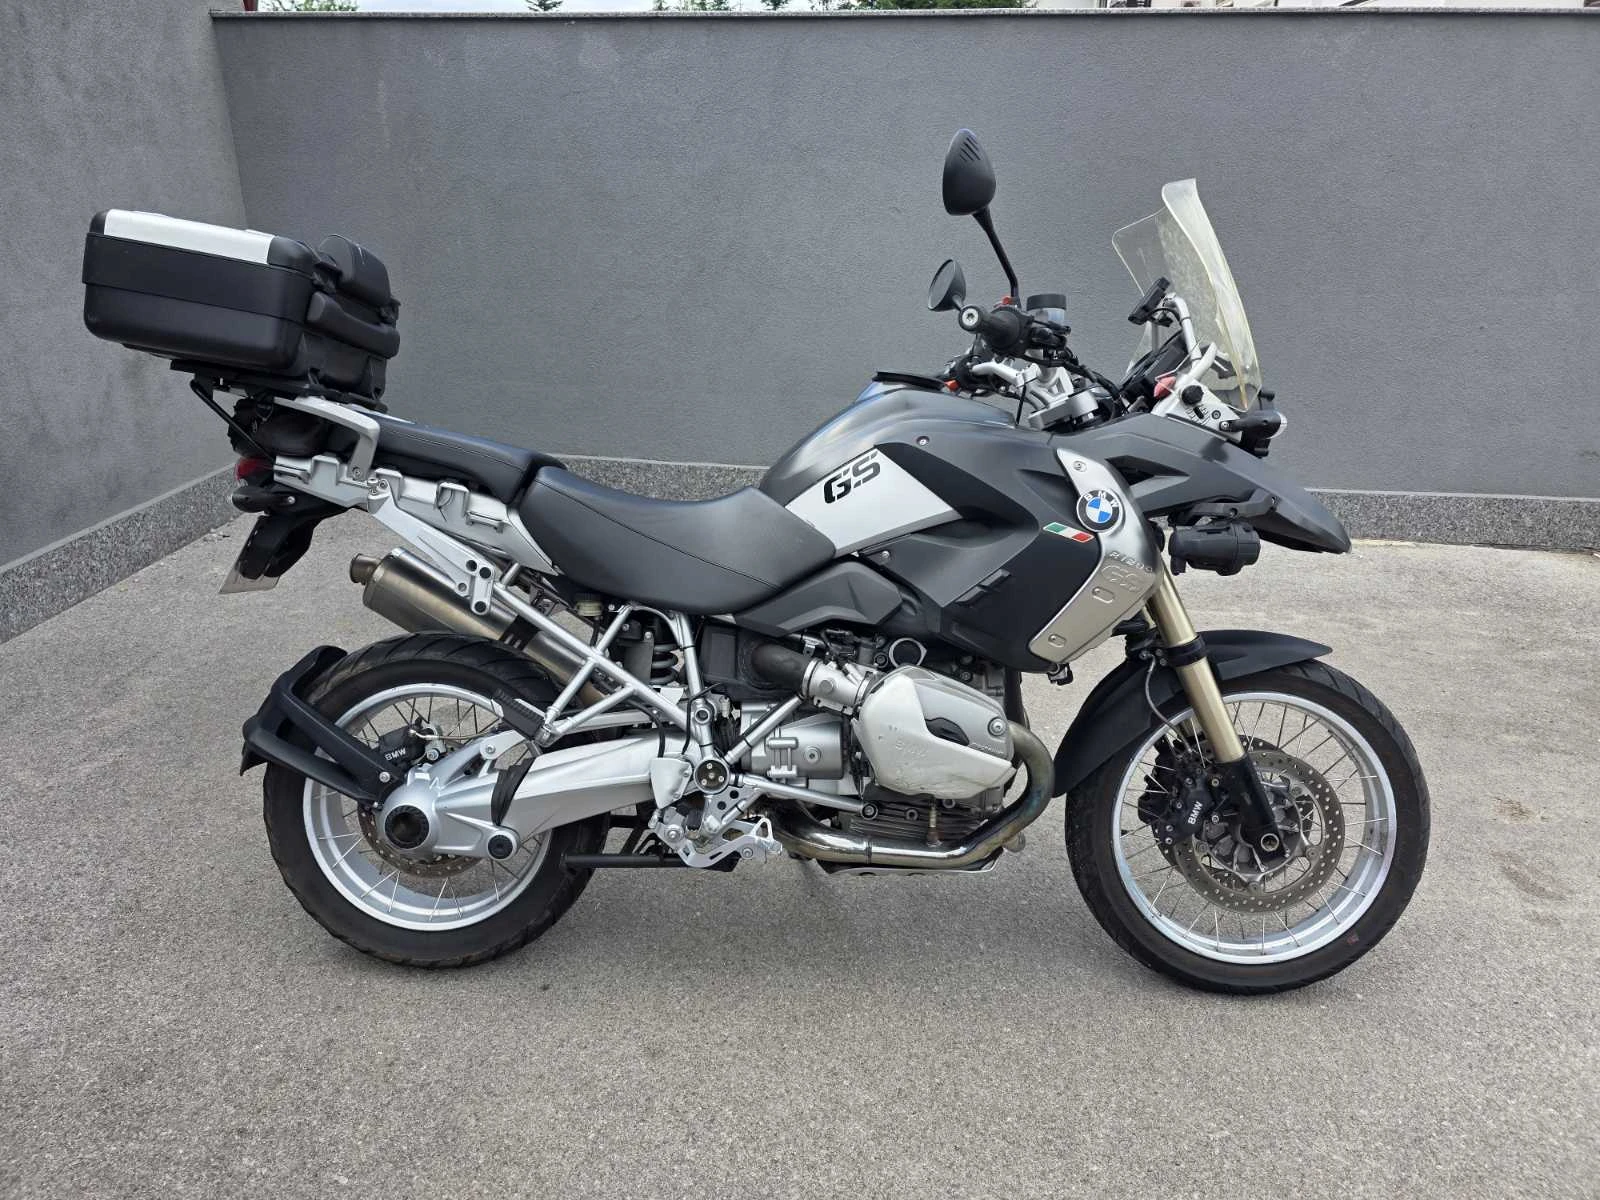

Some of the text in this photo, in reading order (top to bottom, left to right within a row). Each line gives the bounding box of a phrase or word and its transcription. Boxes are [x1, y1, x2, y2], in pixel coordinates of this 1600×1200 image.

[824, 451, 880, 504] GS
[1083, 490, 1120, 507] BMW
[385, 748, 406, 760] BMW
[1187, 801, 1203, 824] BMW
